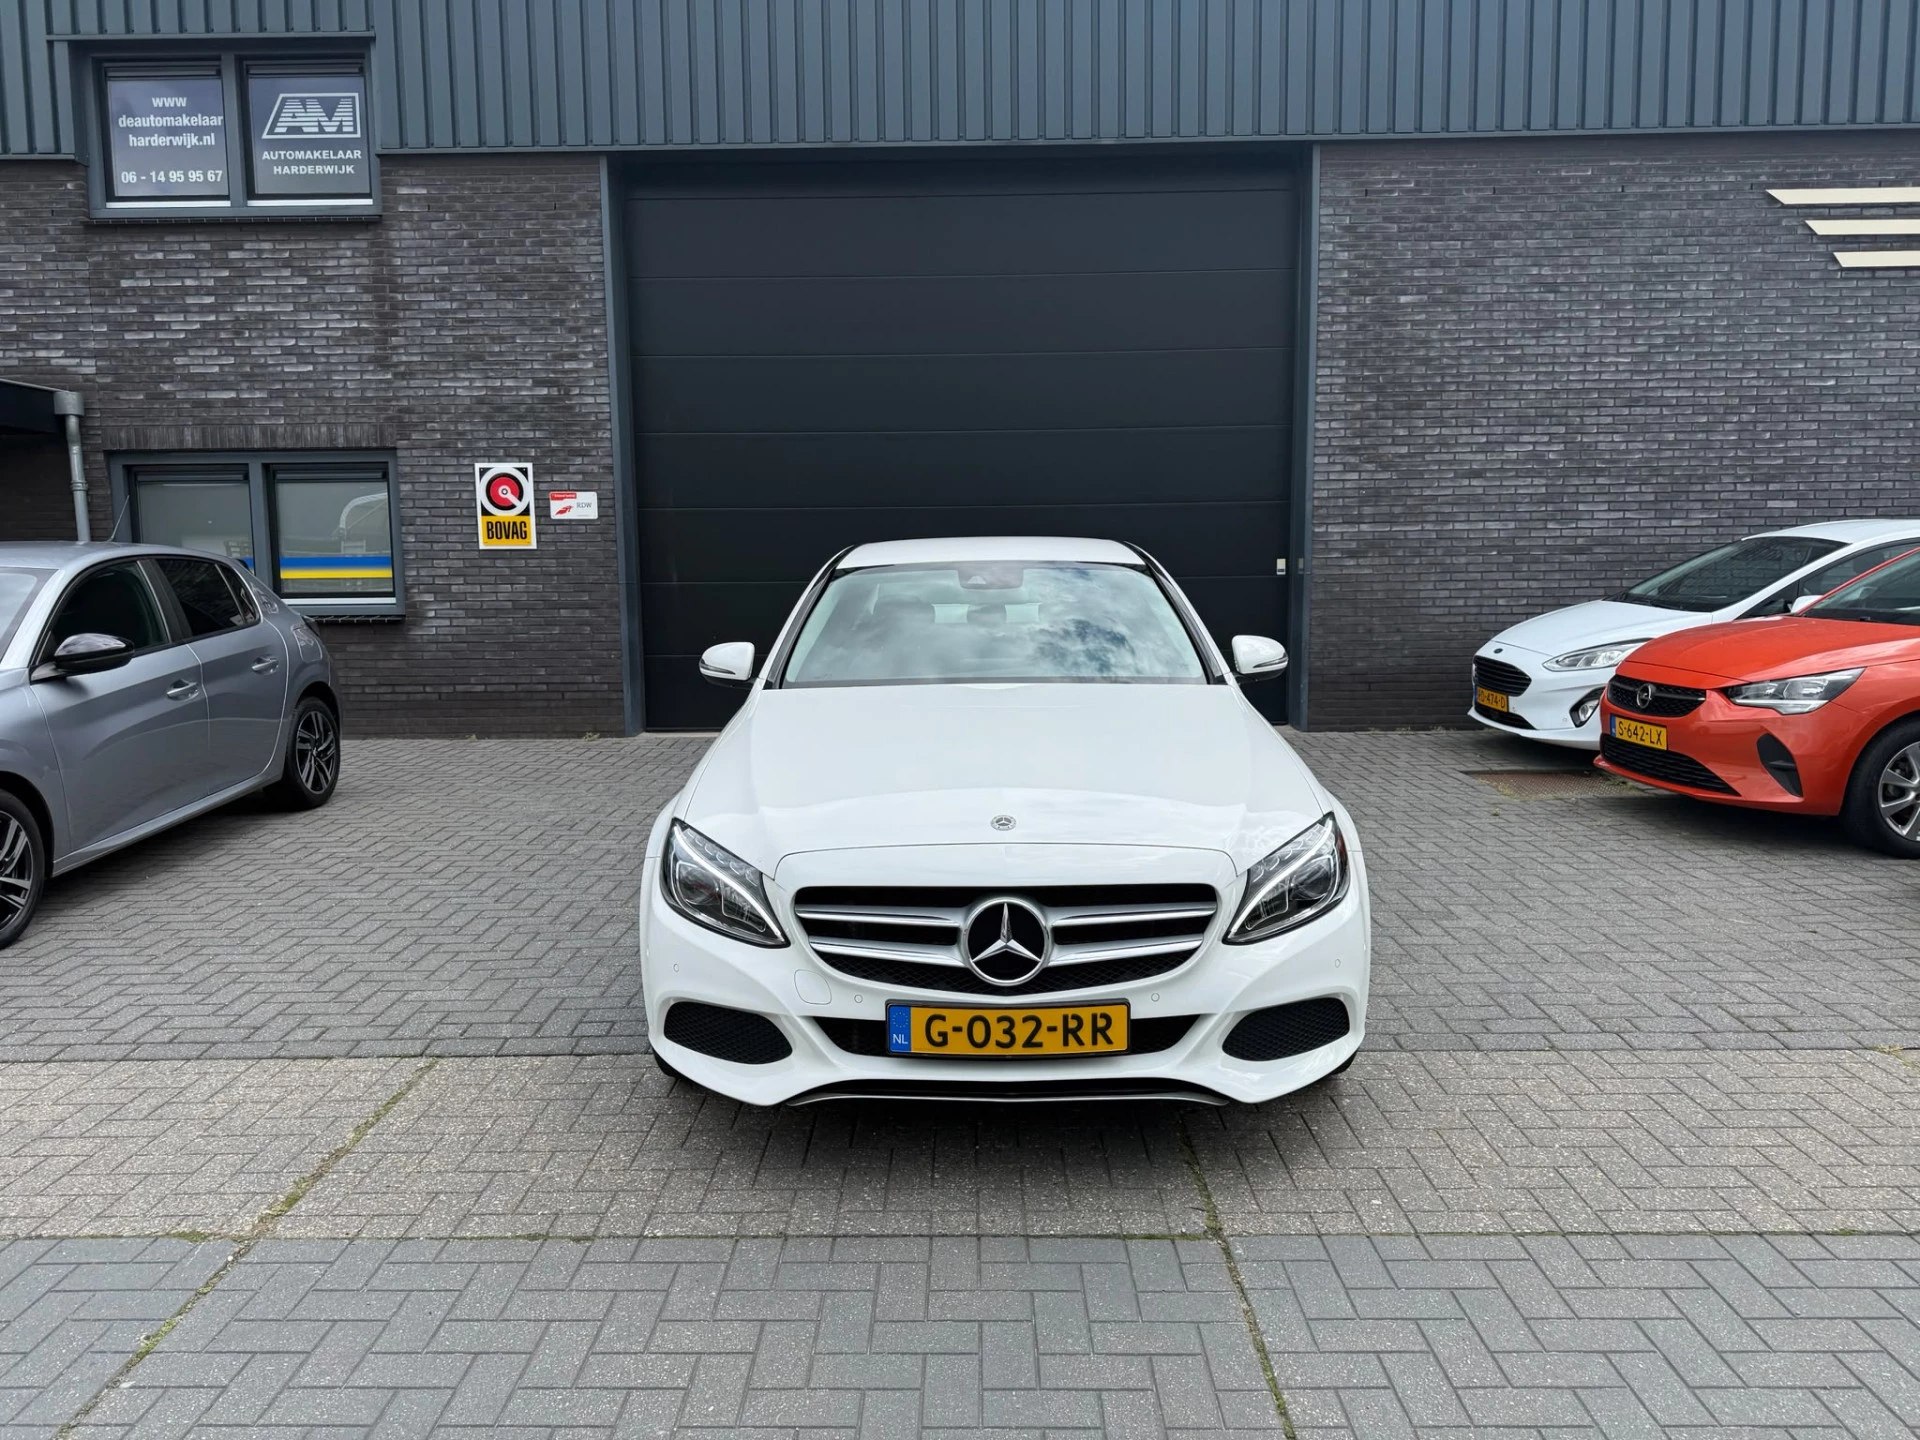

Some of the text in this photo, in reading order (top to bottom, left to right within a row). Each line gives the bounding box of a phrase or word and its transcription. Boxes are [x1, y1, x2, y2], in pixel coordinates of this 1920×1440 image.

[151, 97, 187, 107] www
[118, 113, 224, 128] deautomakelaar
[273, 98, 354, 132] AM
[128, 133, 216, 149] harderwijk.nl
[262, 150, 362, 160] AUTOMAKELAAR
[121, 171, 137, 183] 06
[150, 171, 165, 183] 14
[169, 170, 185, 183] 95
[188, 170, 204, 182] 95
[207, 170, 223, 182] 67
[273, 165, 355, 175] HARDERWIJK
[486, 520, 528, 540] BOVAG
[1618, 720, 1662, 746] S-642-LX
[924, 1012, 1114, 1049] G-032-RR
[892, 1034, 908, 1044] NL
